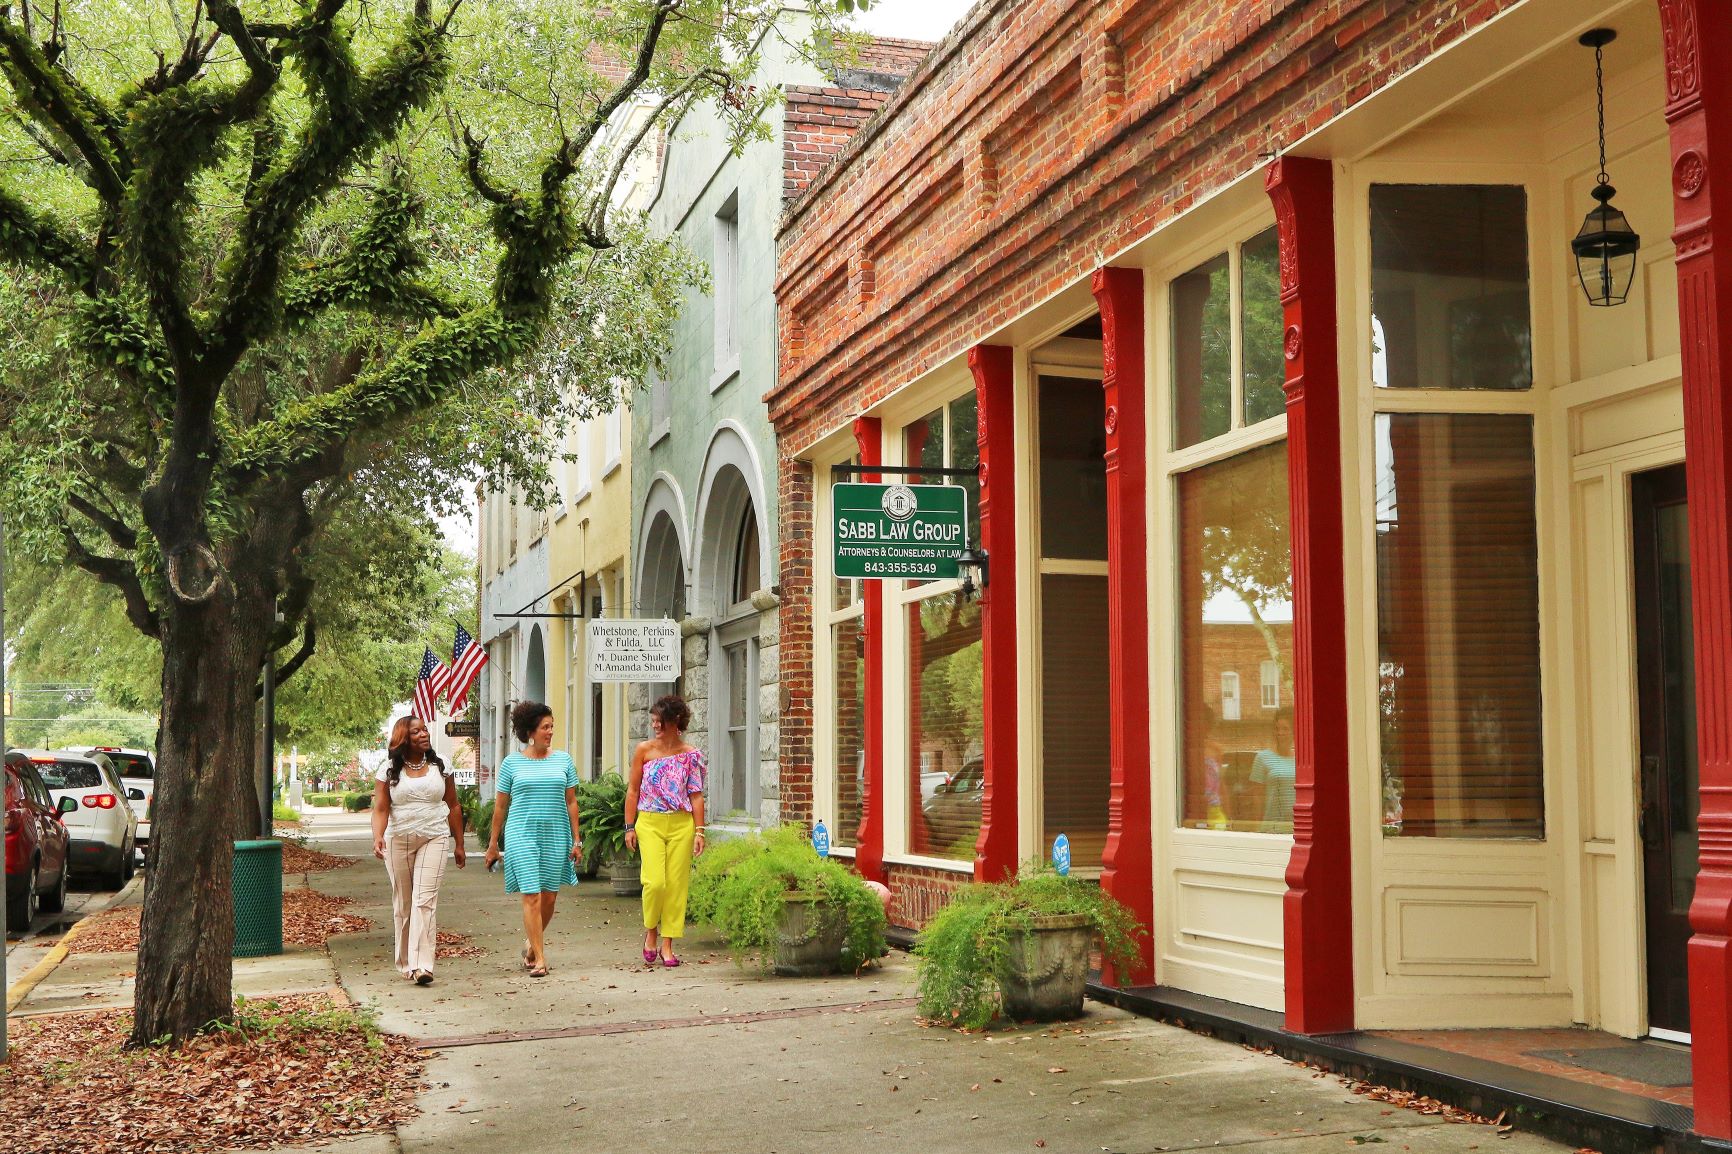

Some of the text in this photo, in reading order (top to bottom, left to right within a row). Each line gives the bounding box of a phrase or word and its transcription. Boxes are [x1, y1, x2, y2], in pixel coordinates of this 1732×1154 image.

[838, 518, 961, 541] SABB LAW GROUP
[838, 546, 962, 558] ATTORNEYS & COUNSELORS AT LAW
[864, 562, 937, 574] 843-355-5349
[592, 626, 675, 637] Whetstone, Perkins
[605, 638, 665, 648] & Fulda, LLC
[597, 653, 670, 661] M. Duane Shuler
[644, 663, 673, 672] Shuler
